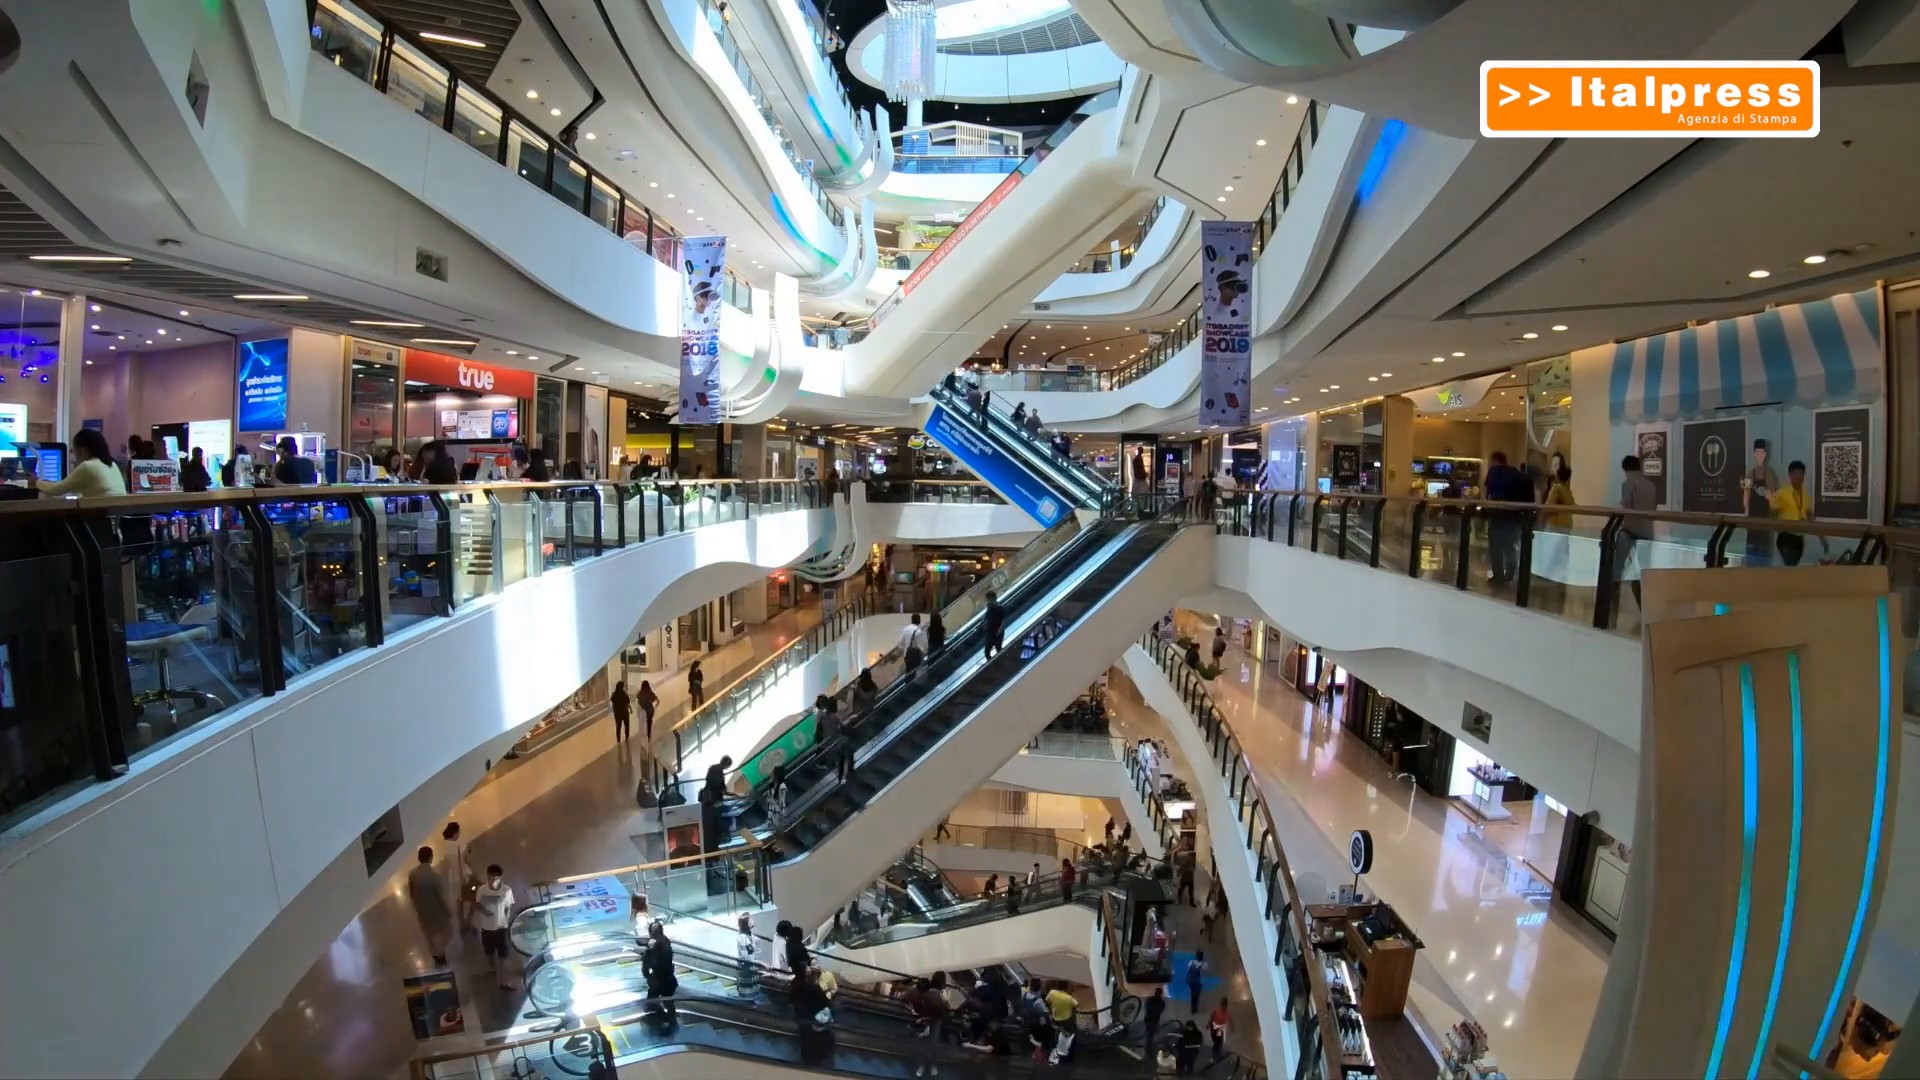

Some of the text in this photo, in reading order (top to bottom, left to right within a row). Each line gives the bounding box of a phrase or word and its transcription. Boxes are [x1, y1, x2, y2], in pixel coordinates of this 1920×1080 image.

[458, 361, 494, 390] true
[1450, 394, 1463, 408] AIS
[1645, 463, 1660, 471] OPEN
